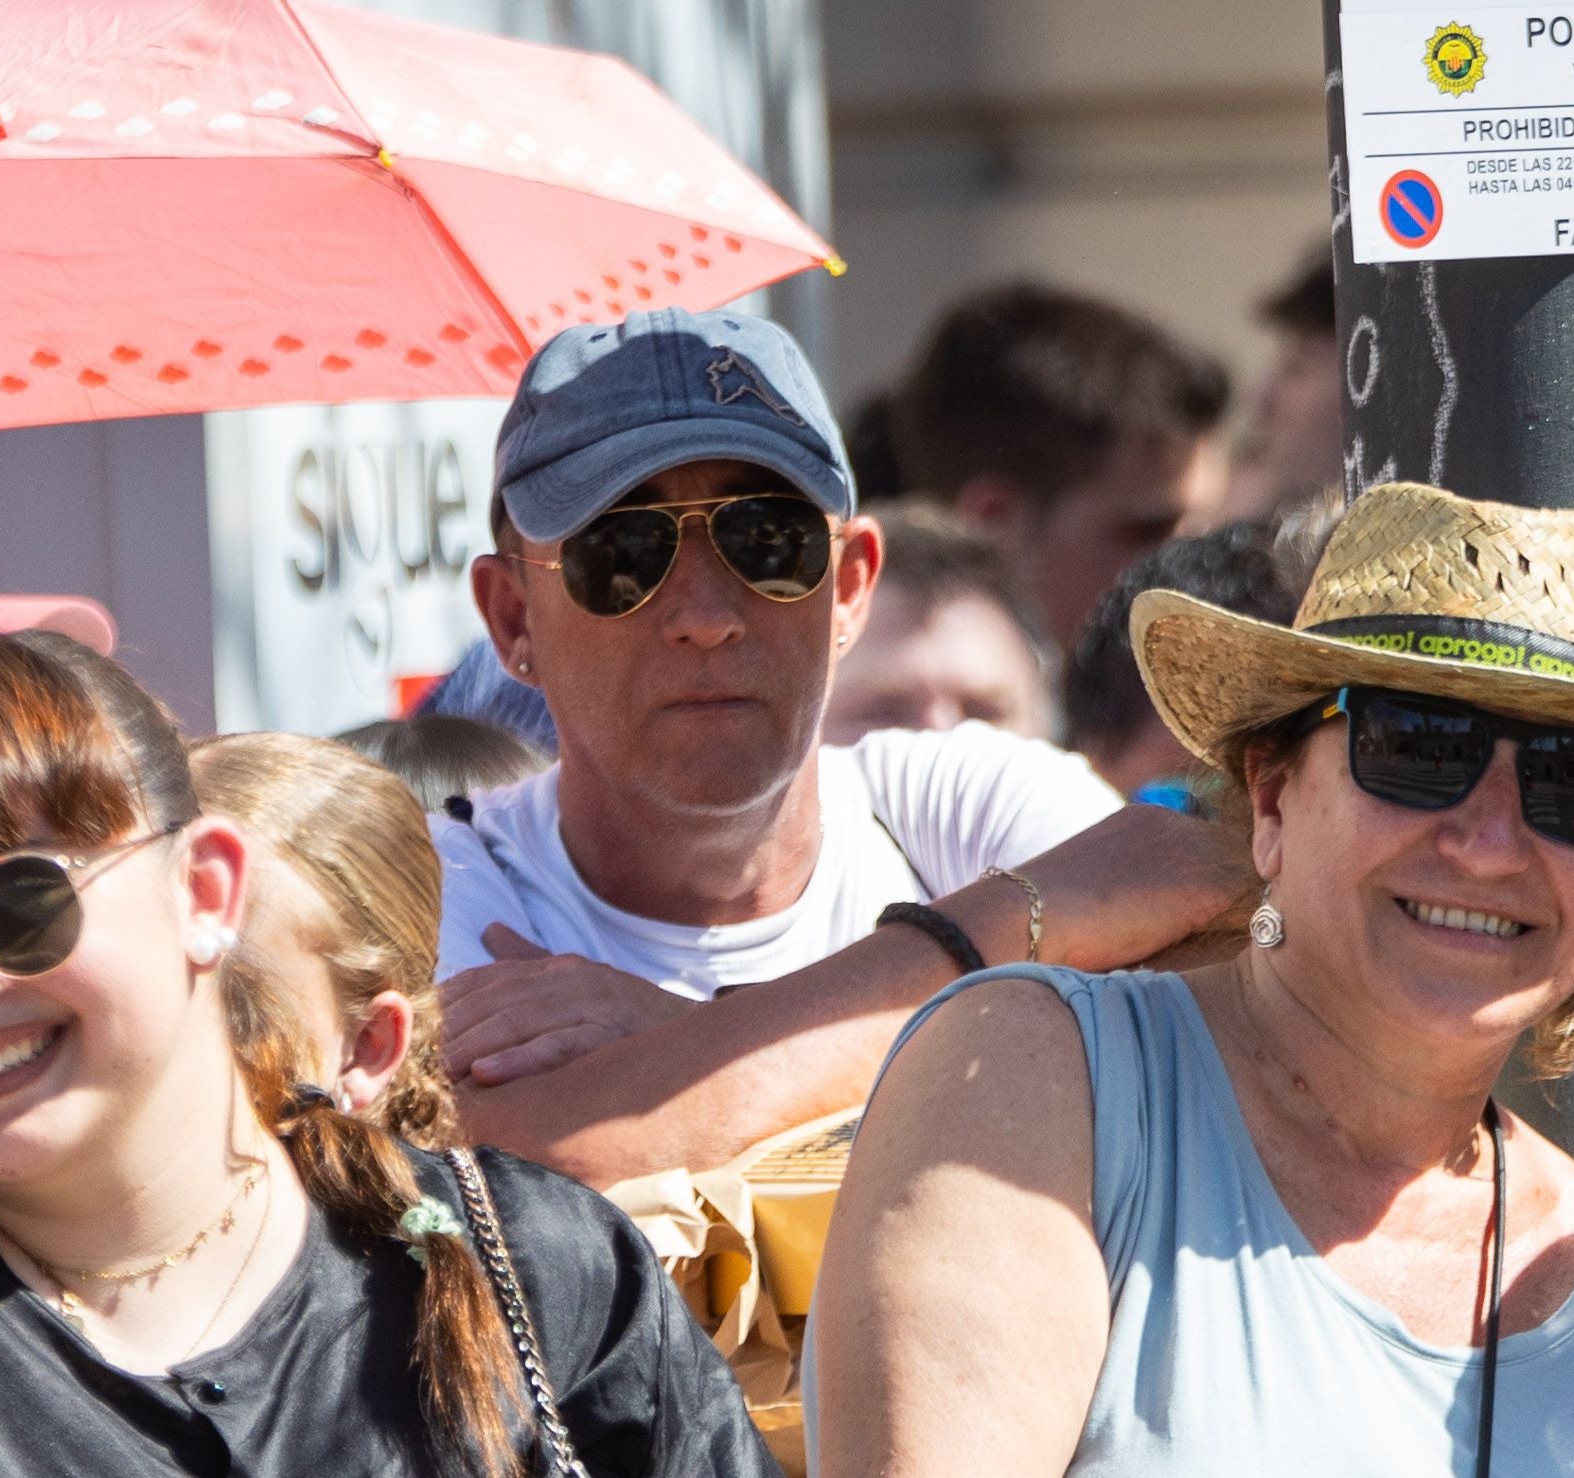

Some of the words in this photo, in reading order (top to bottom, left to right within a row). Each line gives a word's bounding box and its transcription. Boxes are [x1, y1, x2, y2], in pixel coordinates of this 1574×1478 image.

[1466, 159, 1517, 175] DESDE
[1523, 157, 1552, 172] LAS
[1468, 179, 1519, 195] HASTA
[1523, 177, 1552, 192] LAS
